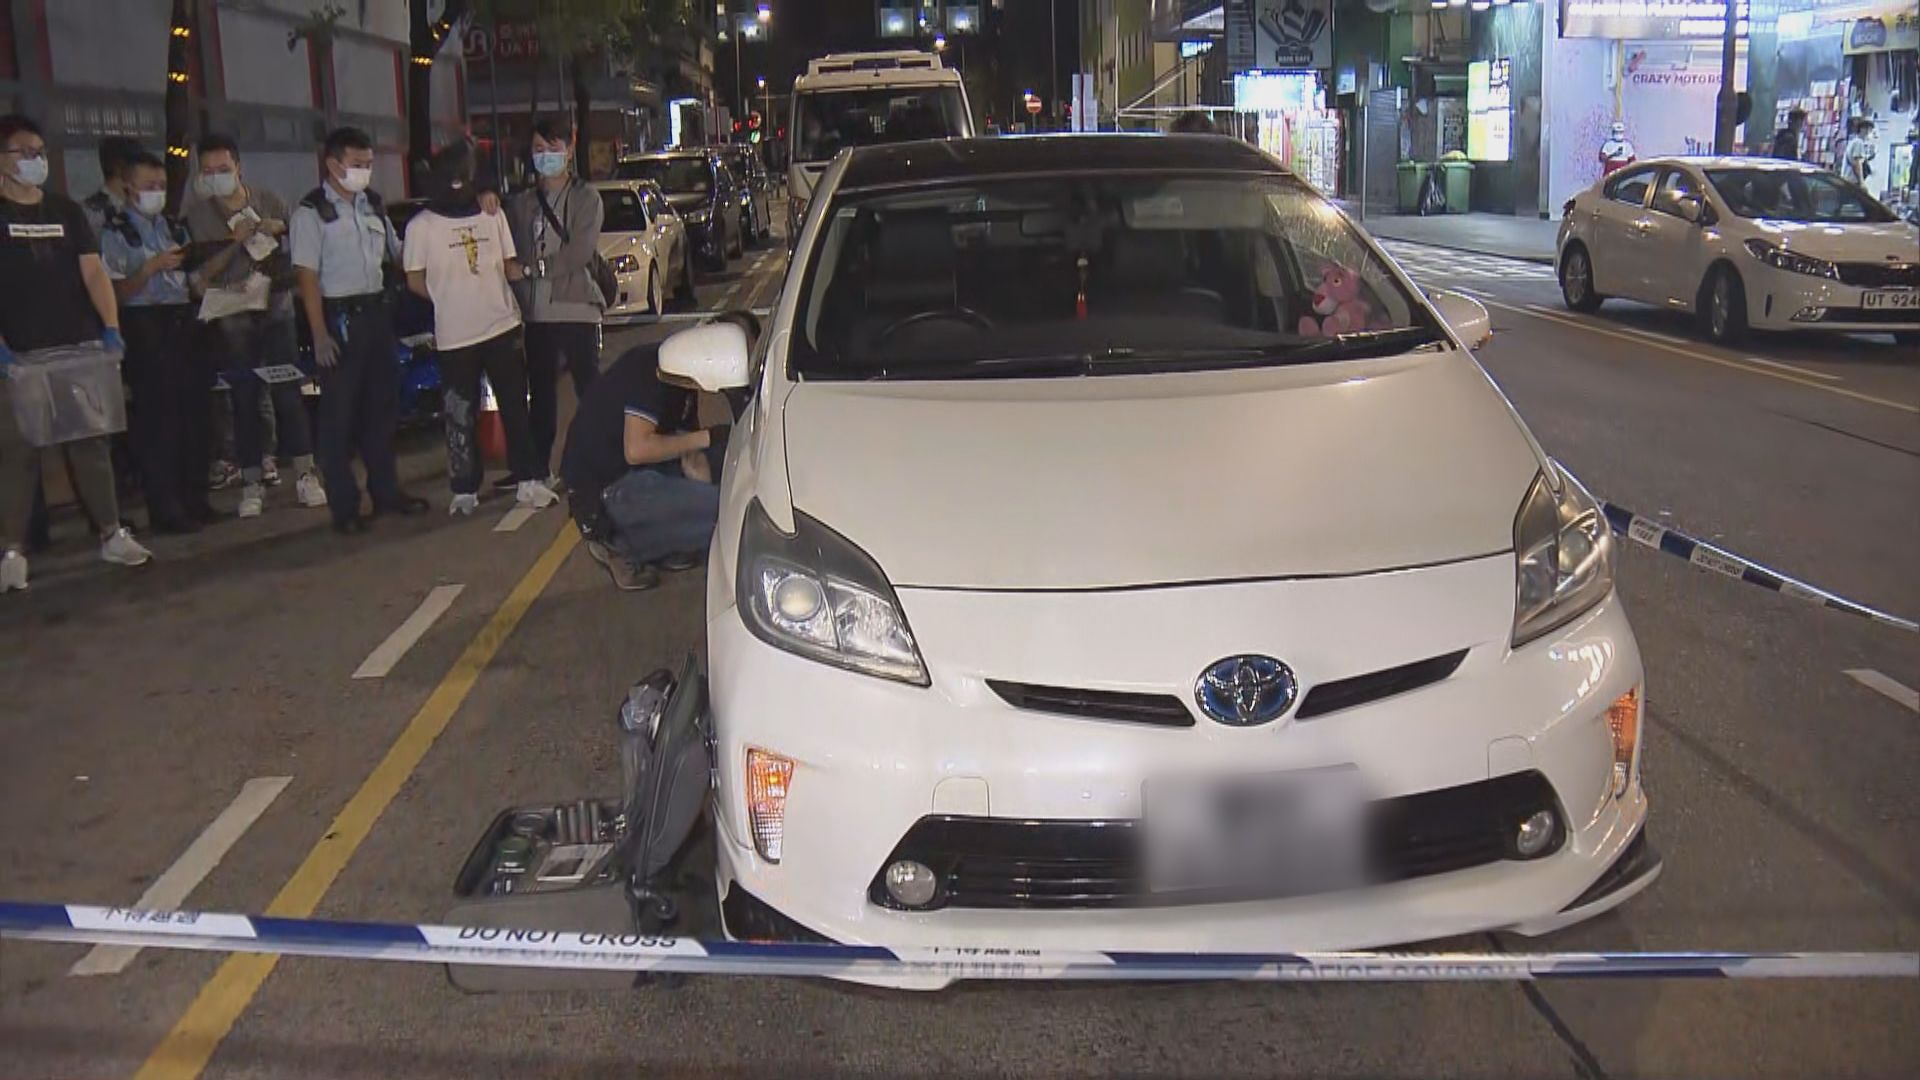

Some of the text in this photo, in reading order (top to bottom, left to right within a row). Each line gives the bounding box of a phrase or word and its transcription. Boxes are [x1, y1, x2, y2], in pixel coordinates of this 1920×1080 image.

[1633, 74, 1671, 84] CRAZY
[1867, 294, 1920, 307] UT 924
[459, 926, 501, 941] DO
